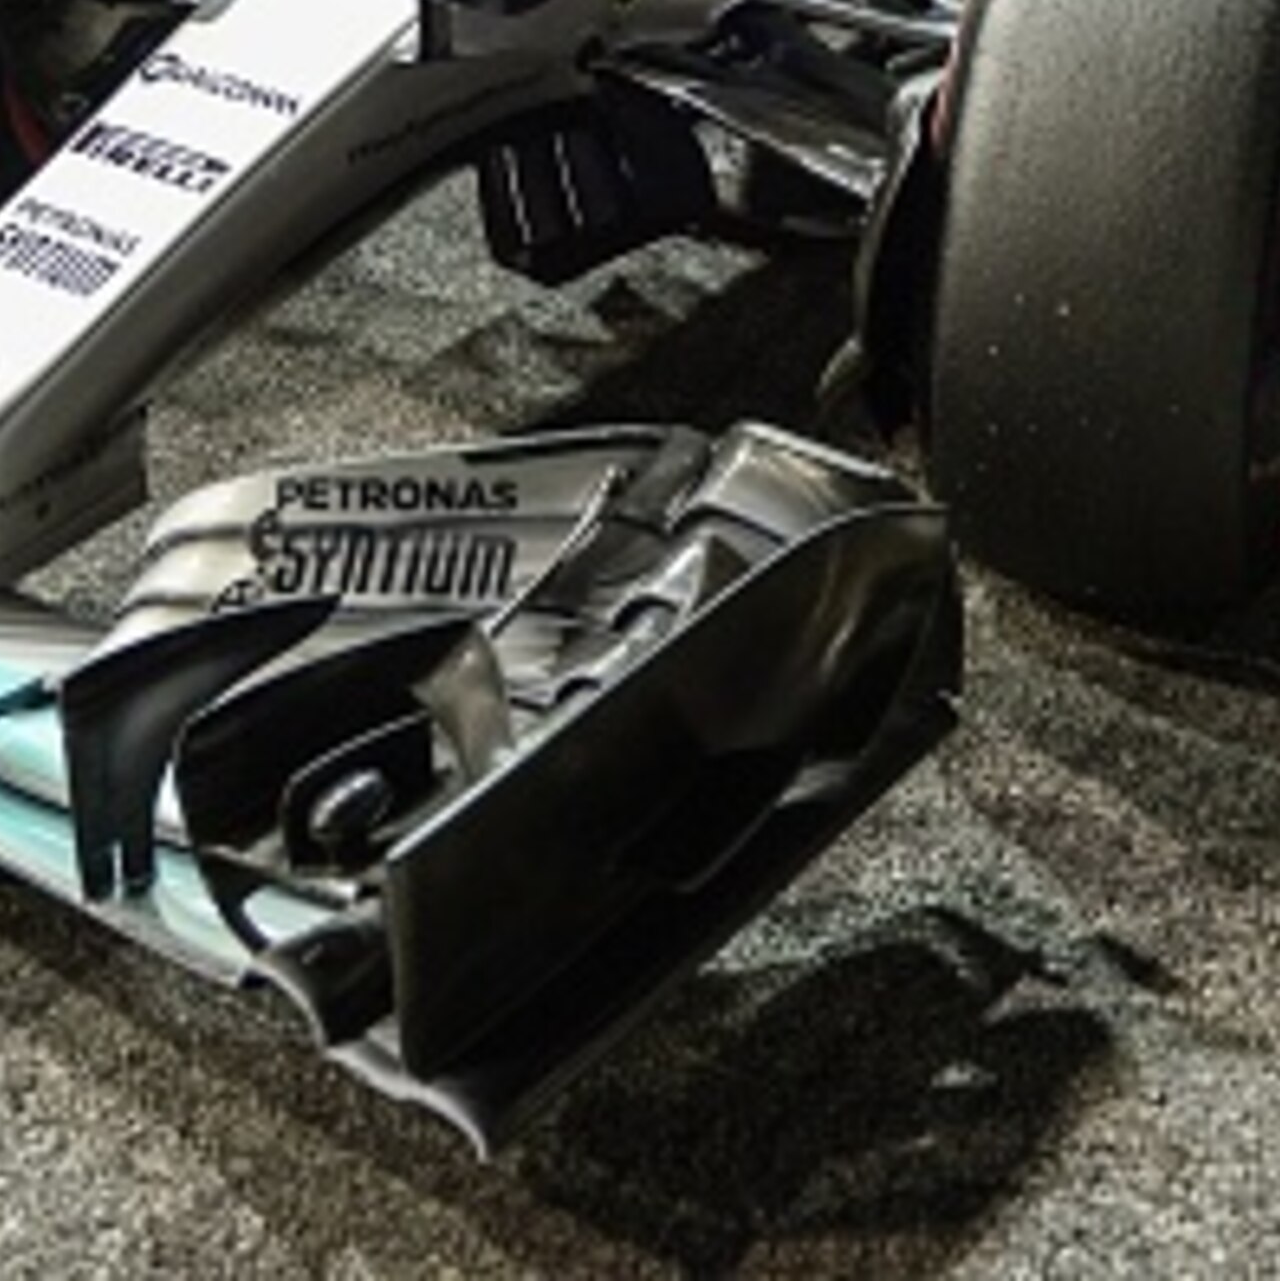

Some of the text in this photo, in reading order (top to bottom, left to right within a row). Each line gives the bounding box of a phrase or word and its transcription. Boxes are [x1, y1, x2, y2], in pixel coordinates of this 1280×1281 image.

[70, 121, 229, 195] PIRELLI
[276, 476, 519, 512] PETRONAS
[272, 524, 517, 599] SYNTIUM
